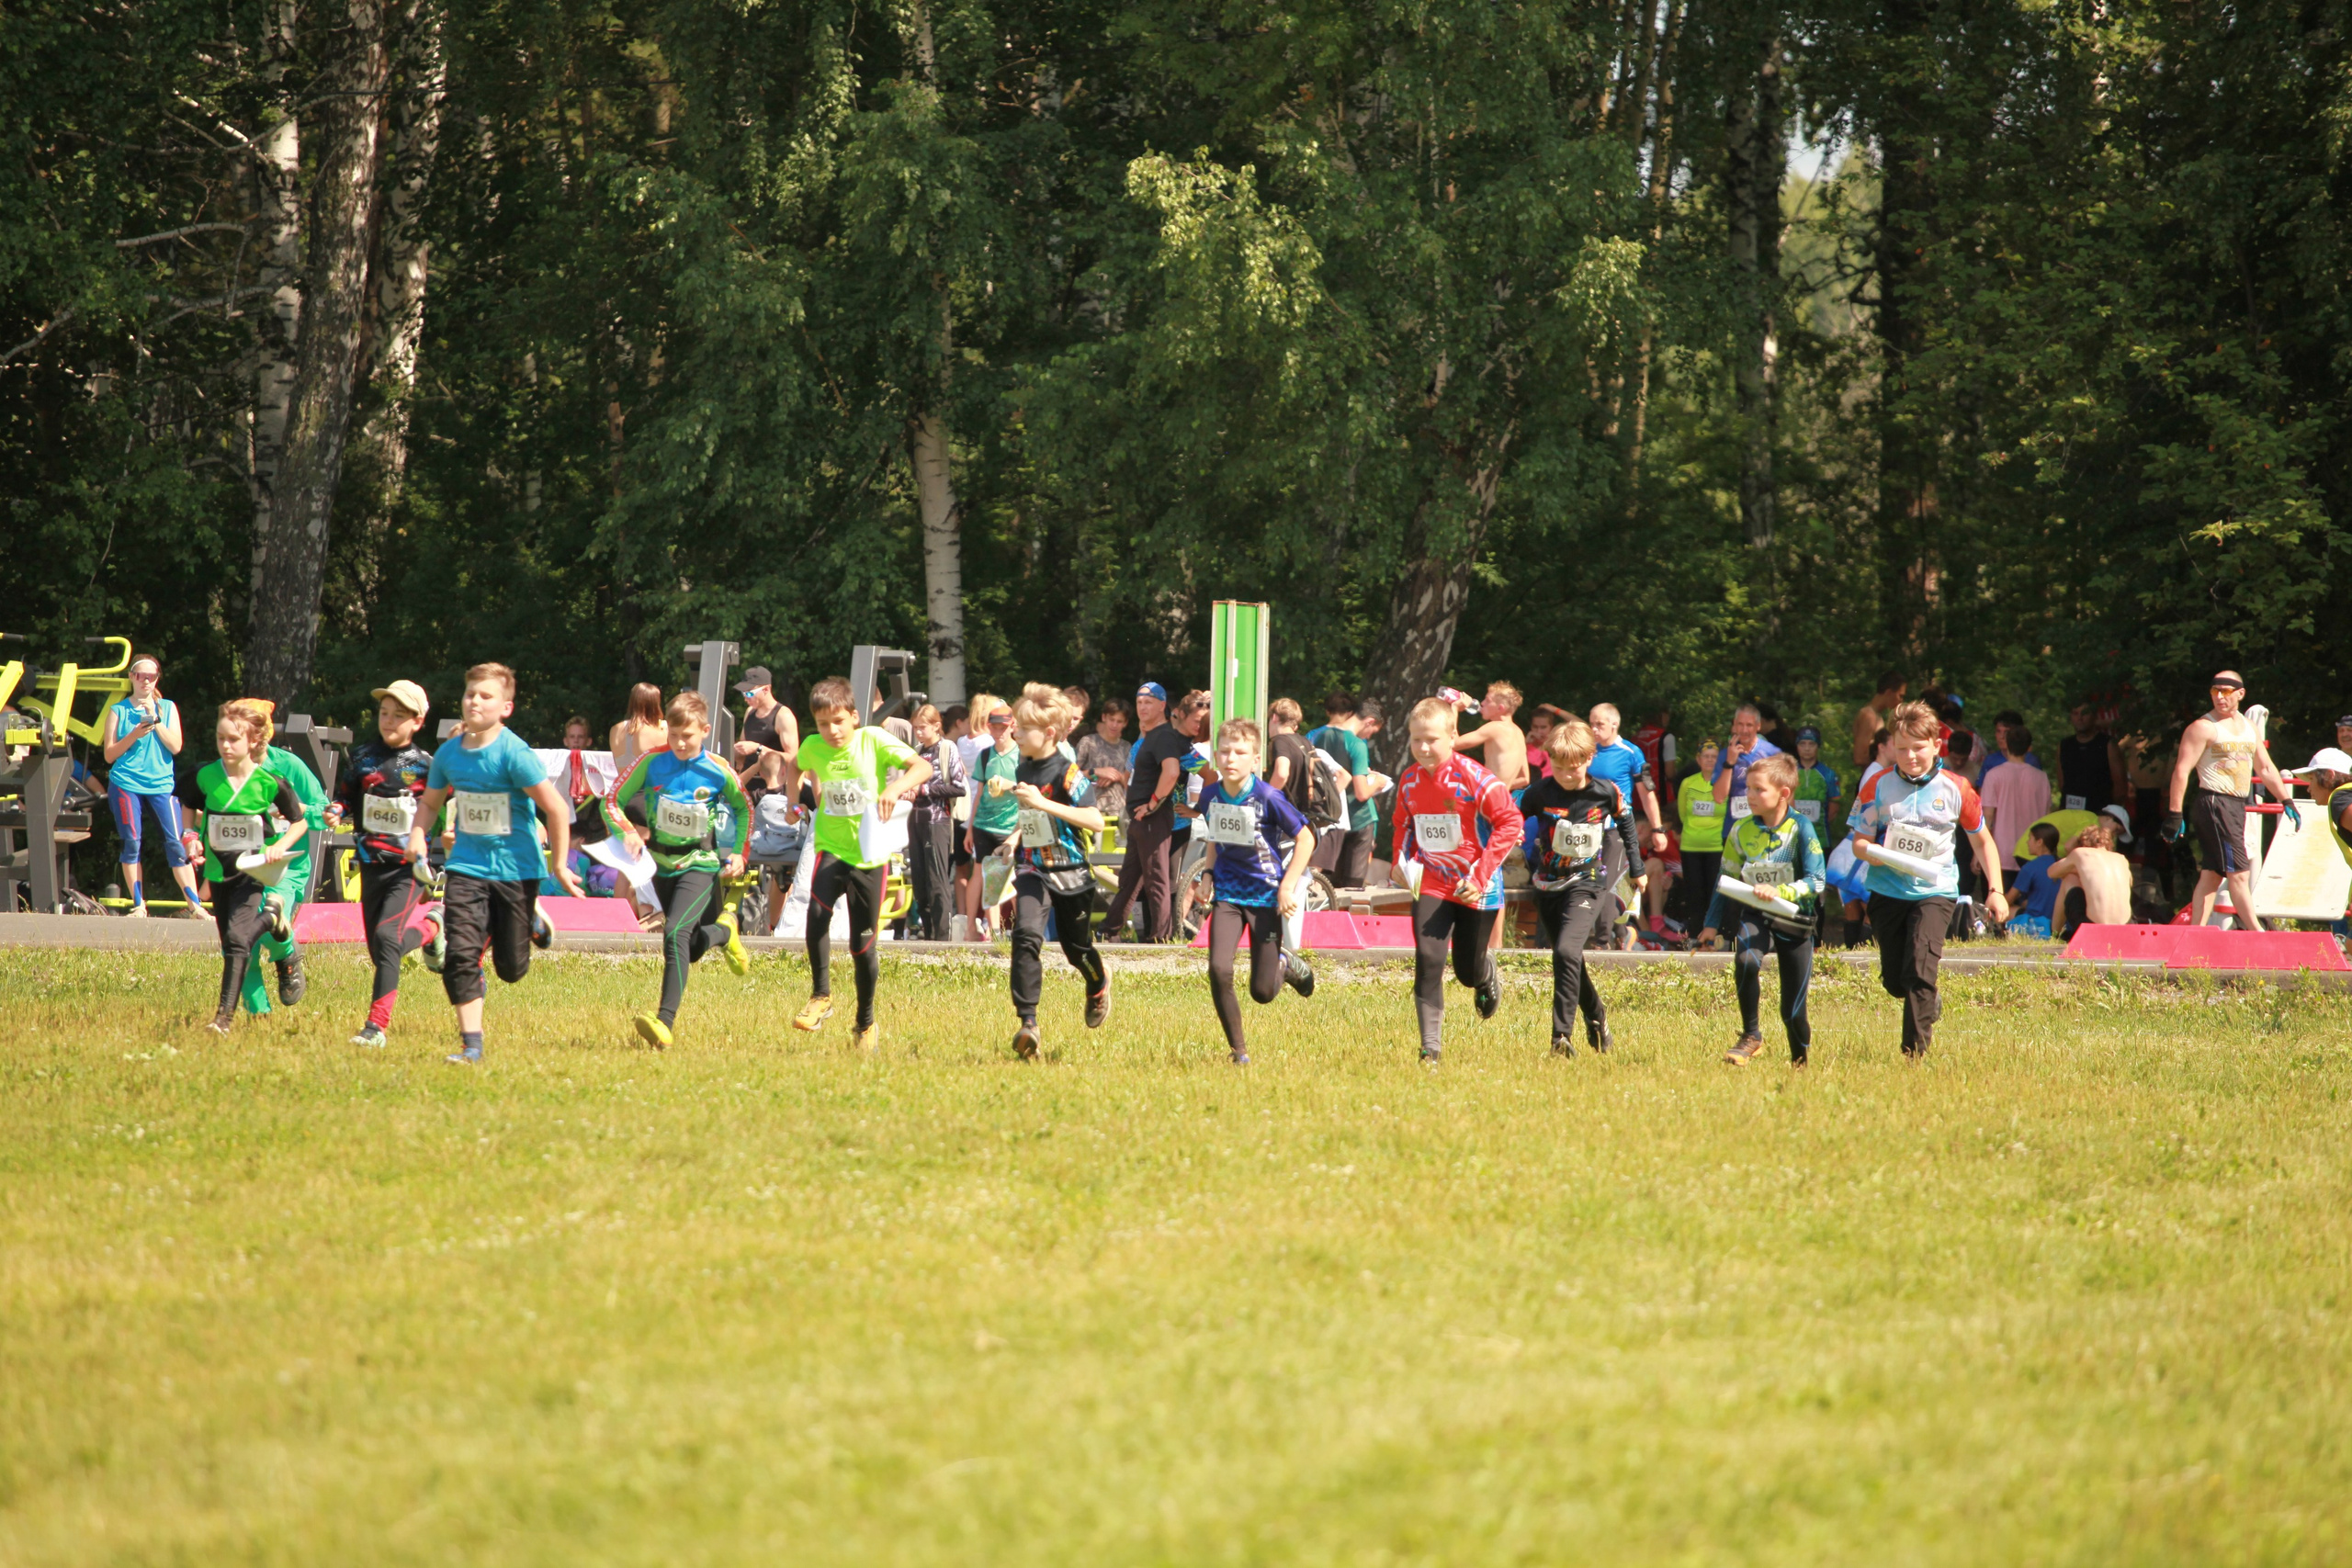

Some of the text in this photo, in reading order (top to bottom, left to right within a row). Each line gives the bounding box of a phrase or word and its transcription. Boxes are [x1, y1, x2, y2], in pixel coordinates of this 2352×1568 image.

[832, 792, 855, 806] 654
[1695, 803, 1710, 811] 927
[373, 809, 399, 824] 646
[469, 808, 492, 822] 647
[668, 811, 691, 827] 653
[1022, 823, 1035, 835] 55
[1220, 818, 1241, 831] 656
[221, 827, 247, 838] 639
[1426, 827, 1447, 839] 636
[1565, 834, 1588, 846] 638
[1898, 838, 1923, 852] 658
[1756, 871, 1778, 884] 637
